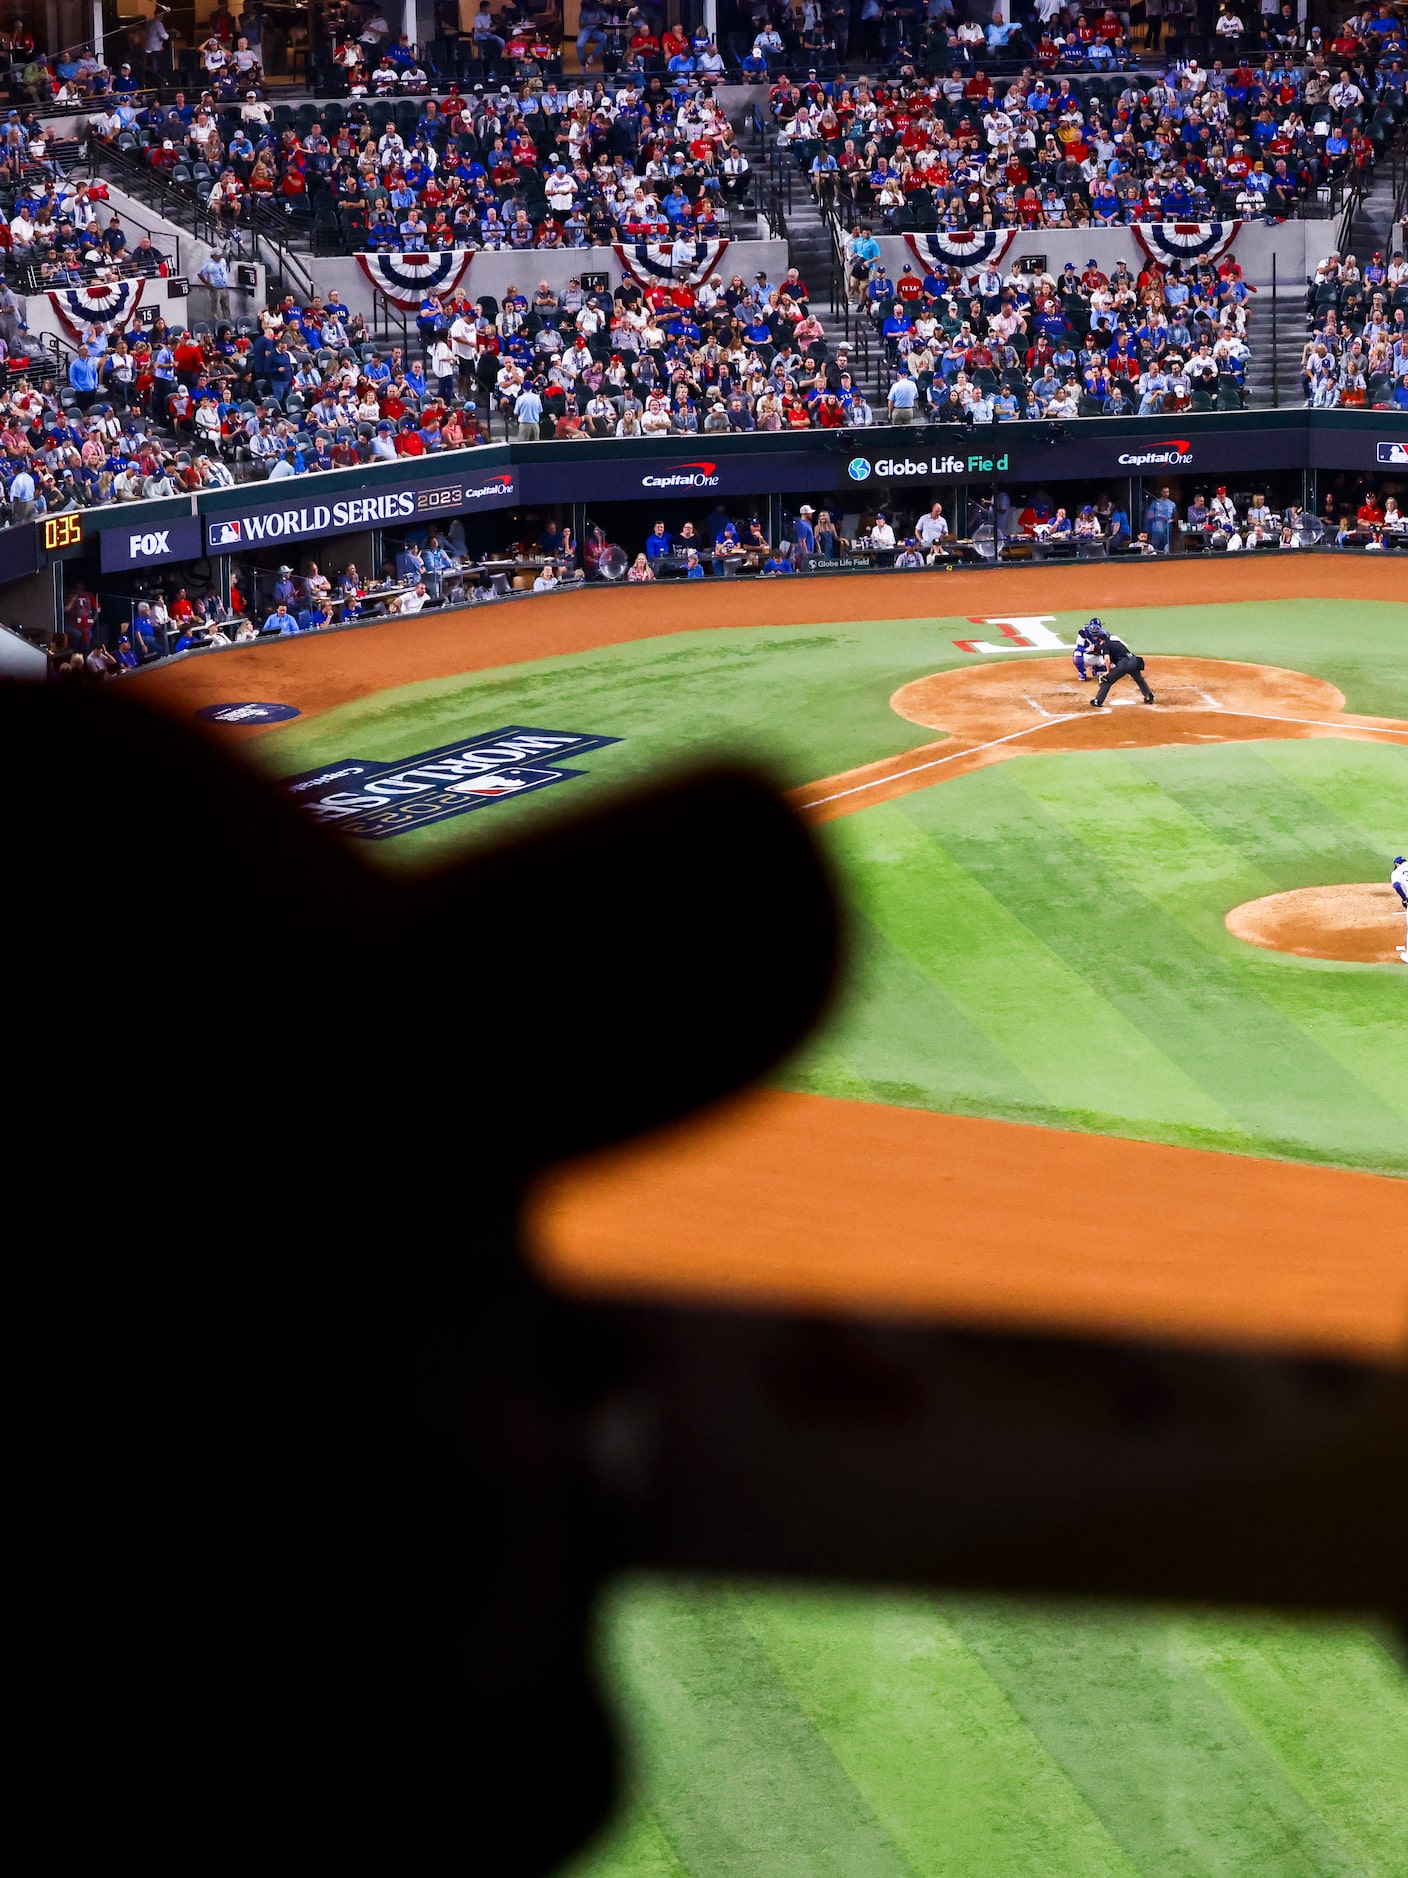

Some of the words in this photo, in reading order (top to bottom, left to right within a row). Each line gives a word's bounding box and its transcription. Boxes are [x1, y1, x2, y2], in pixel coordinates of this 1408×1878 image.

[142, 310, 152, 321] 15
[874, 458, 928, 477] Globe
[932, 456, 964, 473] Life
[967, 454, 1009, 472] Fied
[242, 511, 330, 541] WORLD
[332, 491, 415, 527] SERIES
[417, 489, 463, 508] 2023
[45, 514, 82, 549] 0:35
[130, 530, 170, 559] FOX
[818, 559, 838, 569] Globe
[839, 558, 853, 567] Life
[854, 557, 870, 566] Field
[363, 735, 582, 795] WORLD
